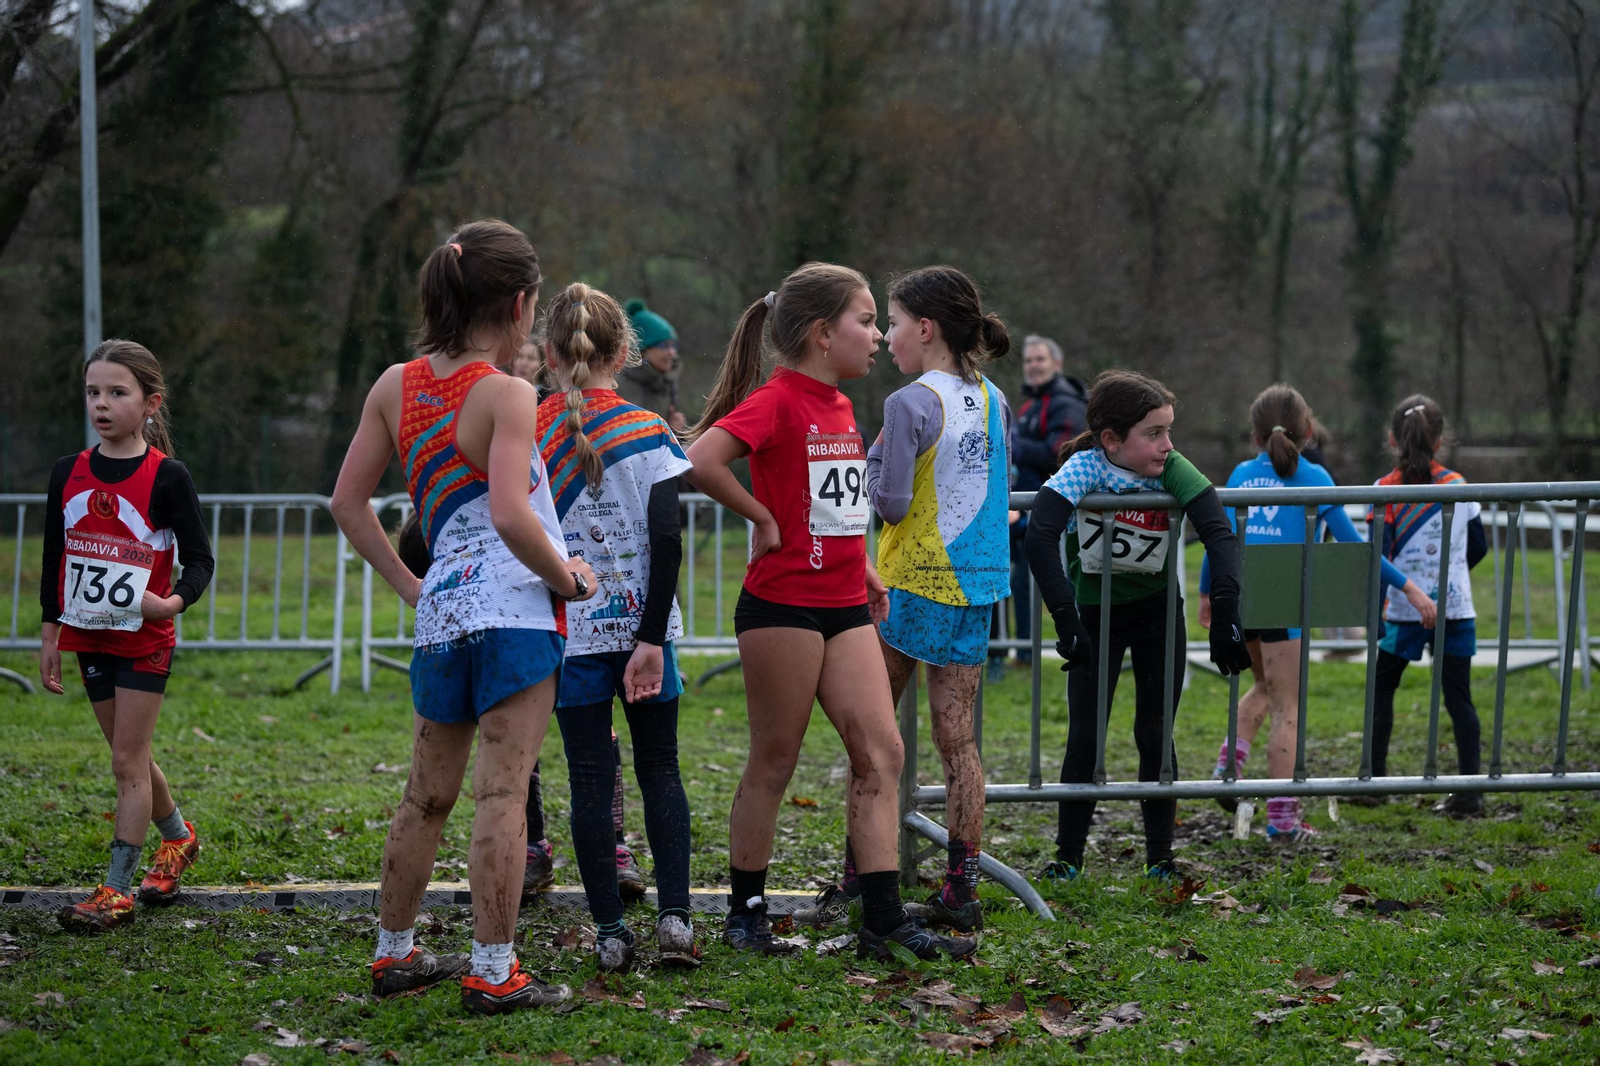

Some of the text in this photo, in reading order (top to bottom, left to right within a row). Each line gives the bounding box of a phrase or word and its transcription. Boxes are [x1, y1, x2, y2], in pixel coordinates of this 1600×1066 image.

[415, 392, 445, 407] ZICO
[807, 443, 860, 456] RIBADAVIA
[578, 501, 621, 512] CAIXA RURAL
[588, 509, 614, 518] GALEGA
[466, 525, 489, 534] RURAL
[100, 534, 130, 545] Alejandro
[1081, 517, 1162, 563] 757
[67, 538, 153, 564] RIBADAVIA 2026
[810, 535, 823, 570] Cor
[71, 562, 135, 608] 736
